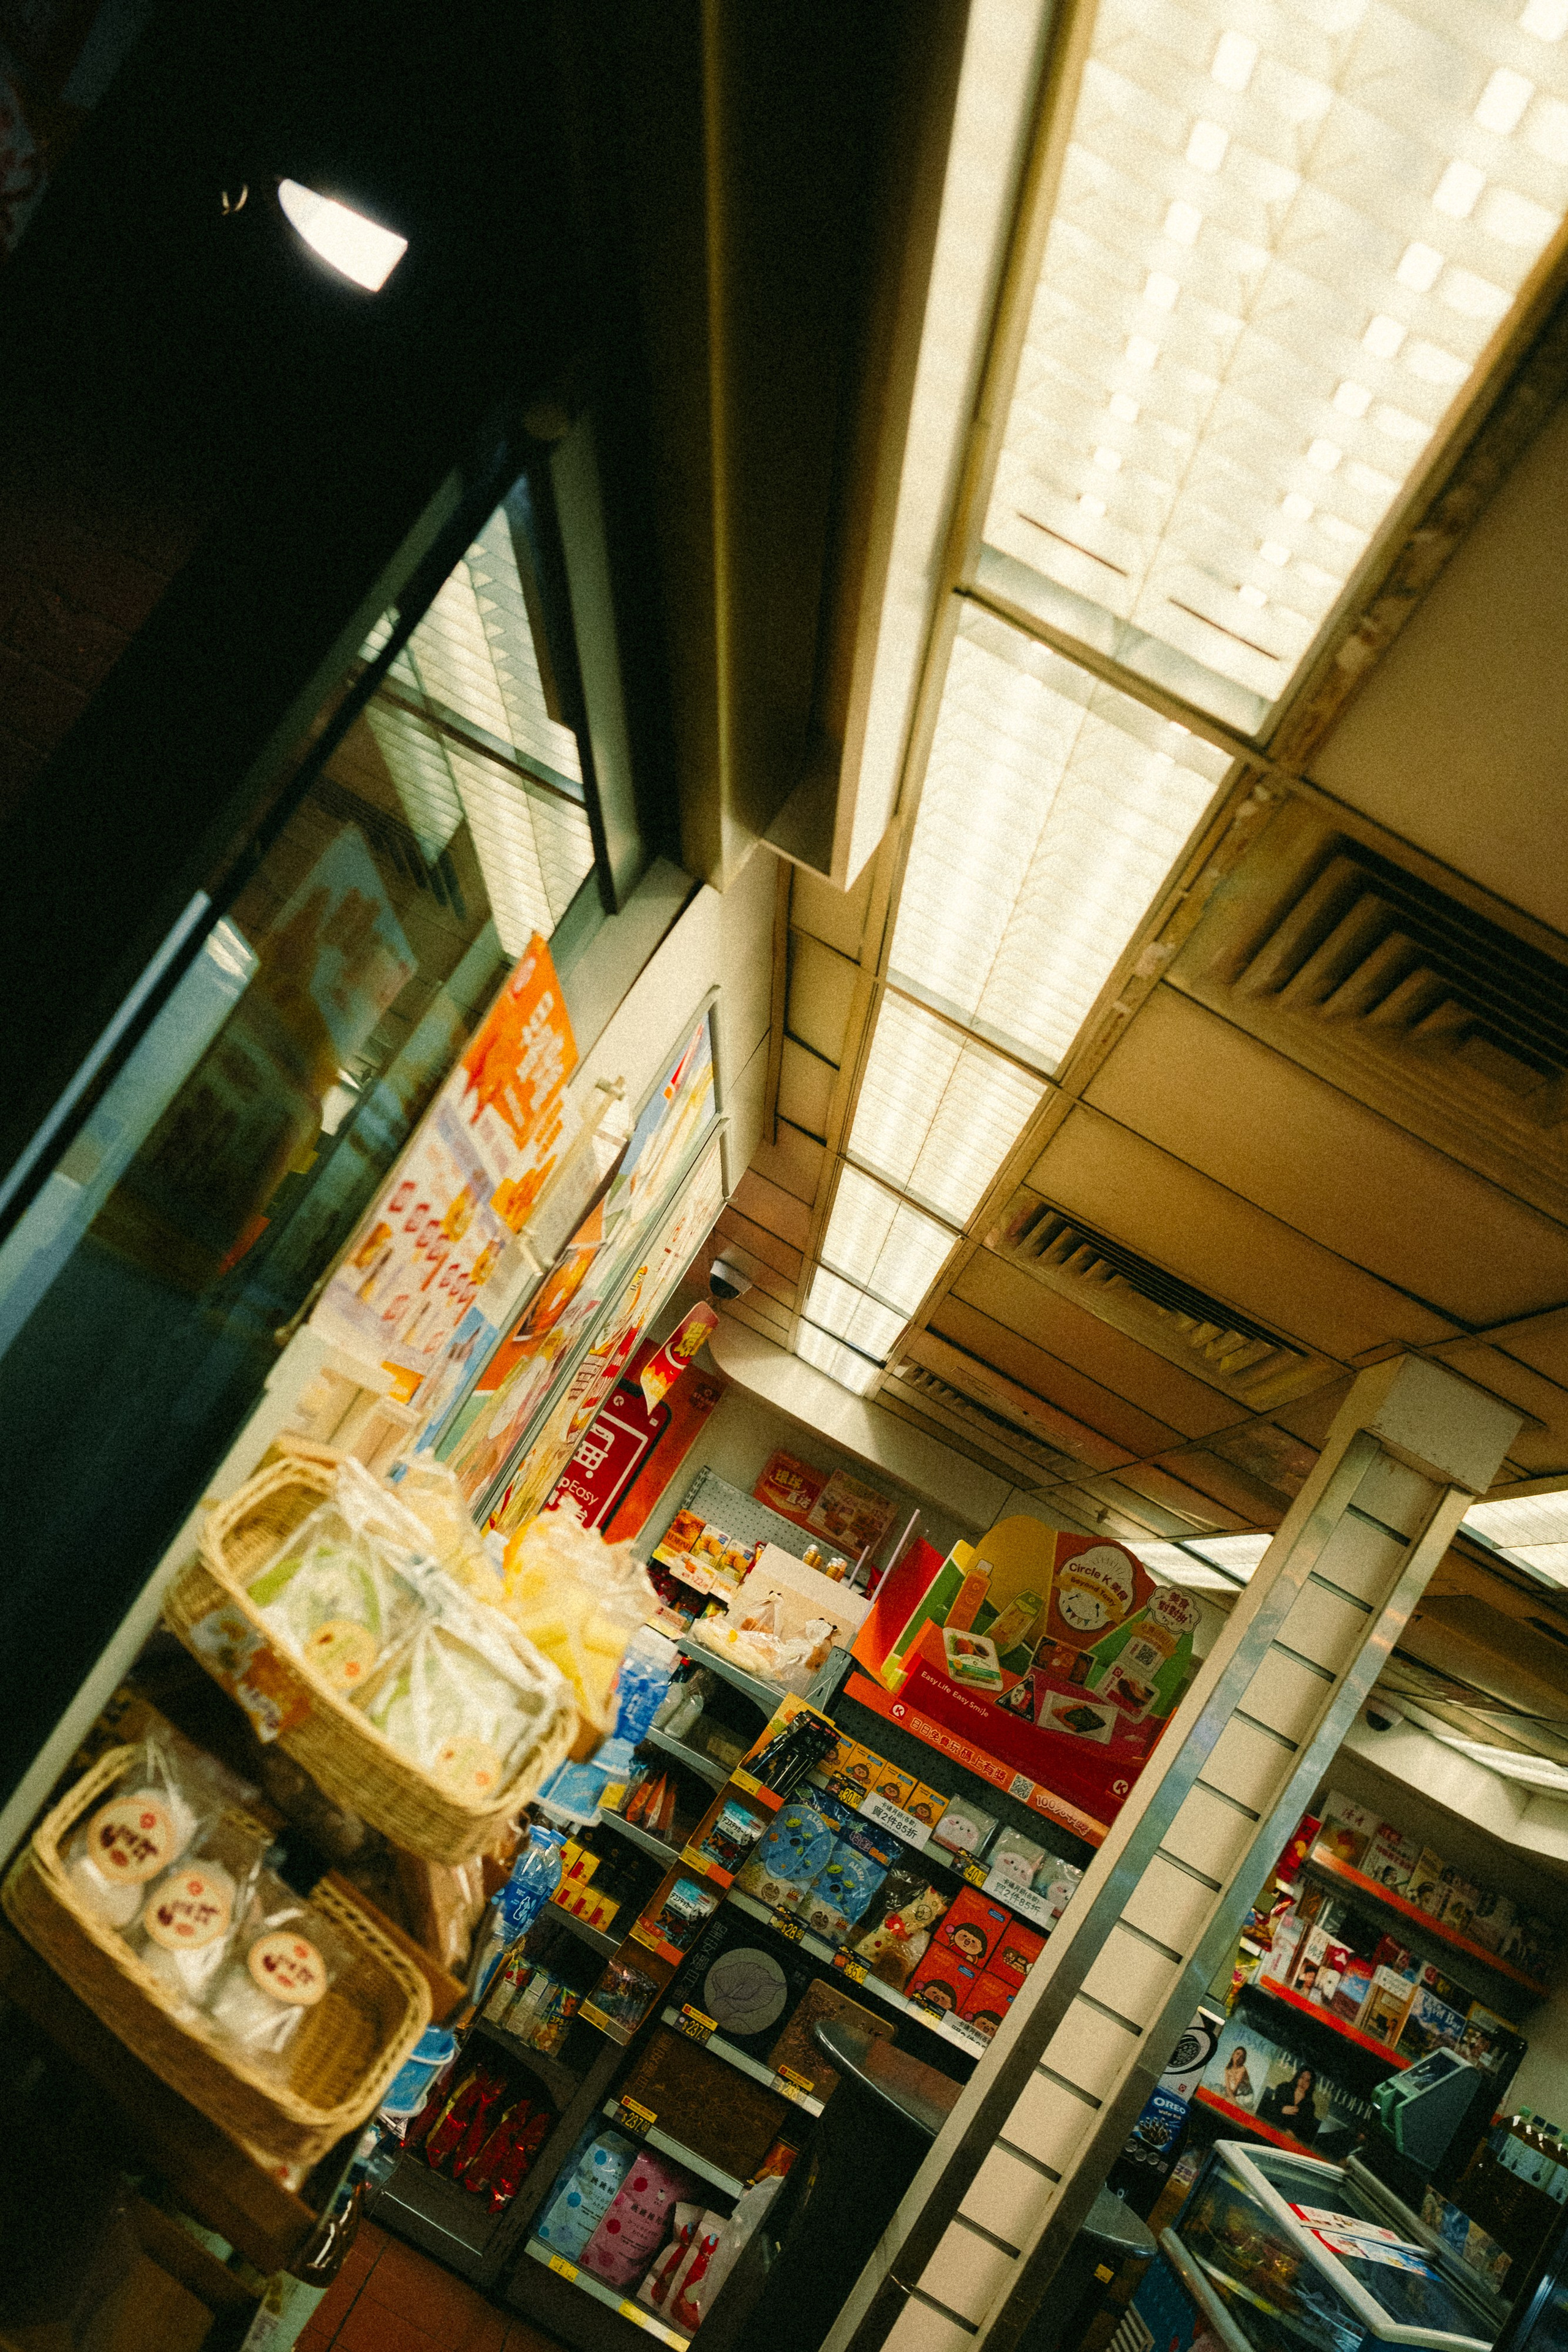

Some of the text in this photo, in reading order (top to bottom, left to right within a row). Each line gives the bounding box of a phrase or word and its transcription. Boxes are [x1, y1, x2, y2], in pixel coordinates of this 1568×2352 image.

[1068, 1562, 1101, 1580] Circle
[1101, 1574, 1112, 1585] K
[1071, 1577, 1117, 1607] Beyond Tasty
[1167, 1591, 1191, 1610] 美食
[920, 1670, 990, 1718] Easy Life Easy Smile
[910, 1718, 960, 1752] 日日免費玩
[837, 1785, 862, 1809] $30.00
[805, 1813, 824, 1834] ALIEN
[870, 1805, 918, 1840] 買2件85折
[848, 1861, 865, 1882] ALIEN
[961, 1863, 988, 1887] $40.00
[993, 1882, 1041, 1916] 買2件85折
[680, 2019, 711, 2040] $237.00
[1152, 2095, 1187, 2115] OREO
[620, 2112, 650, 2132] $237.00
